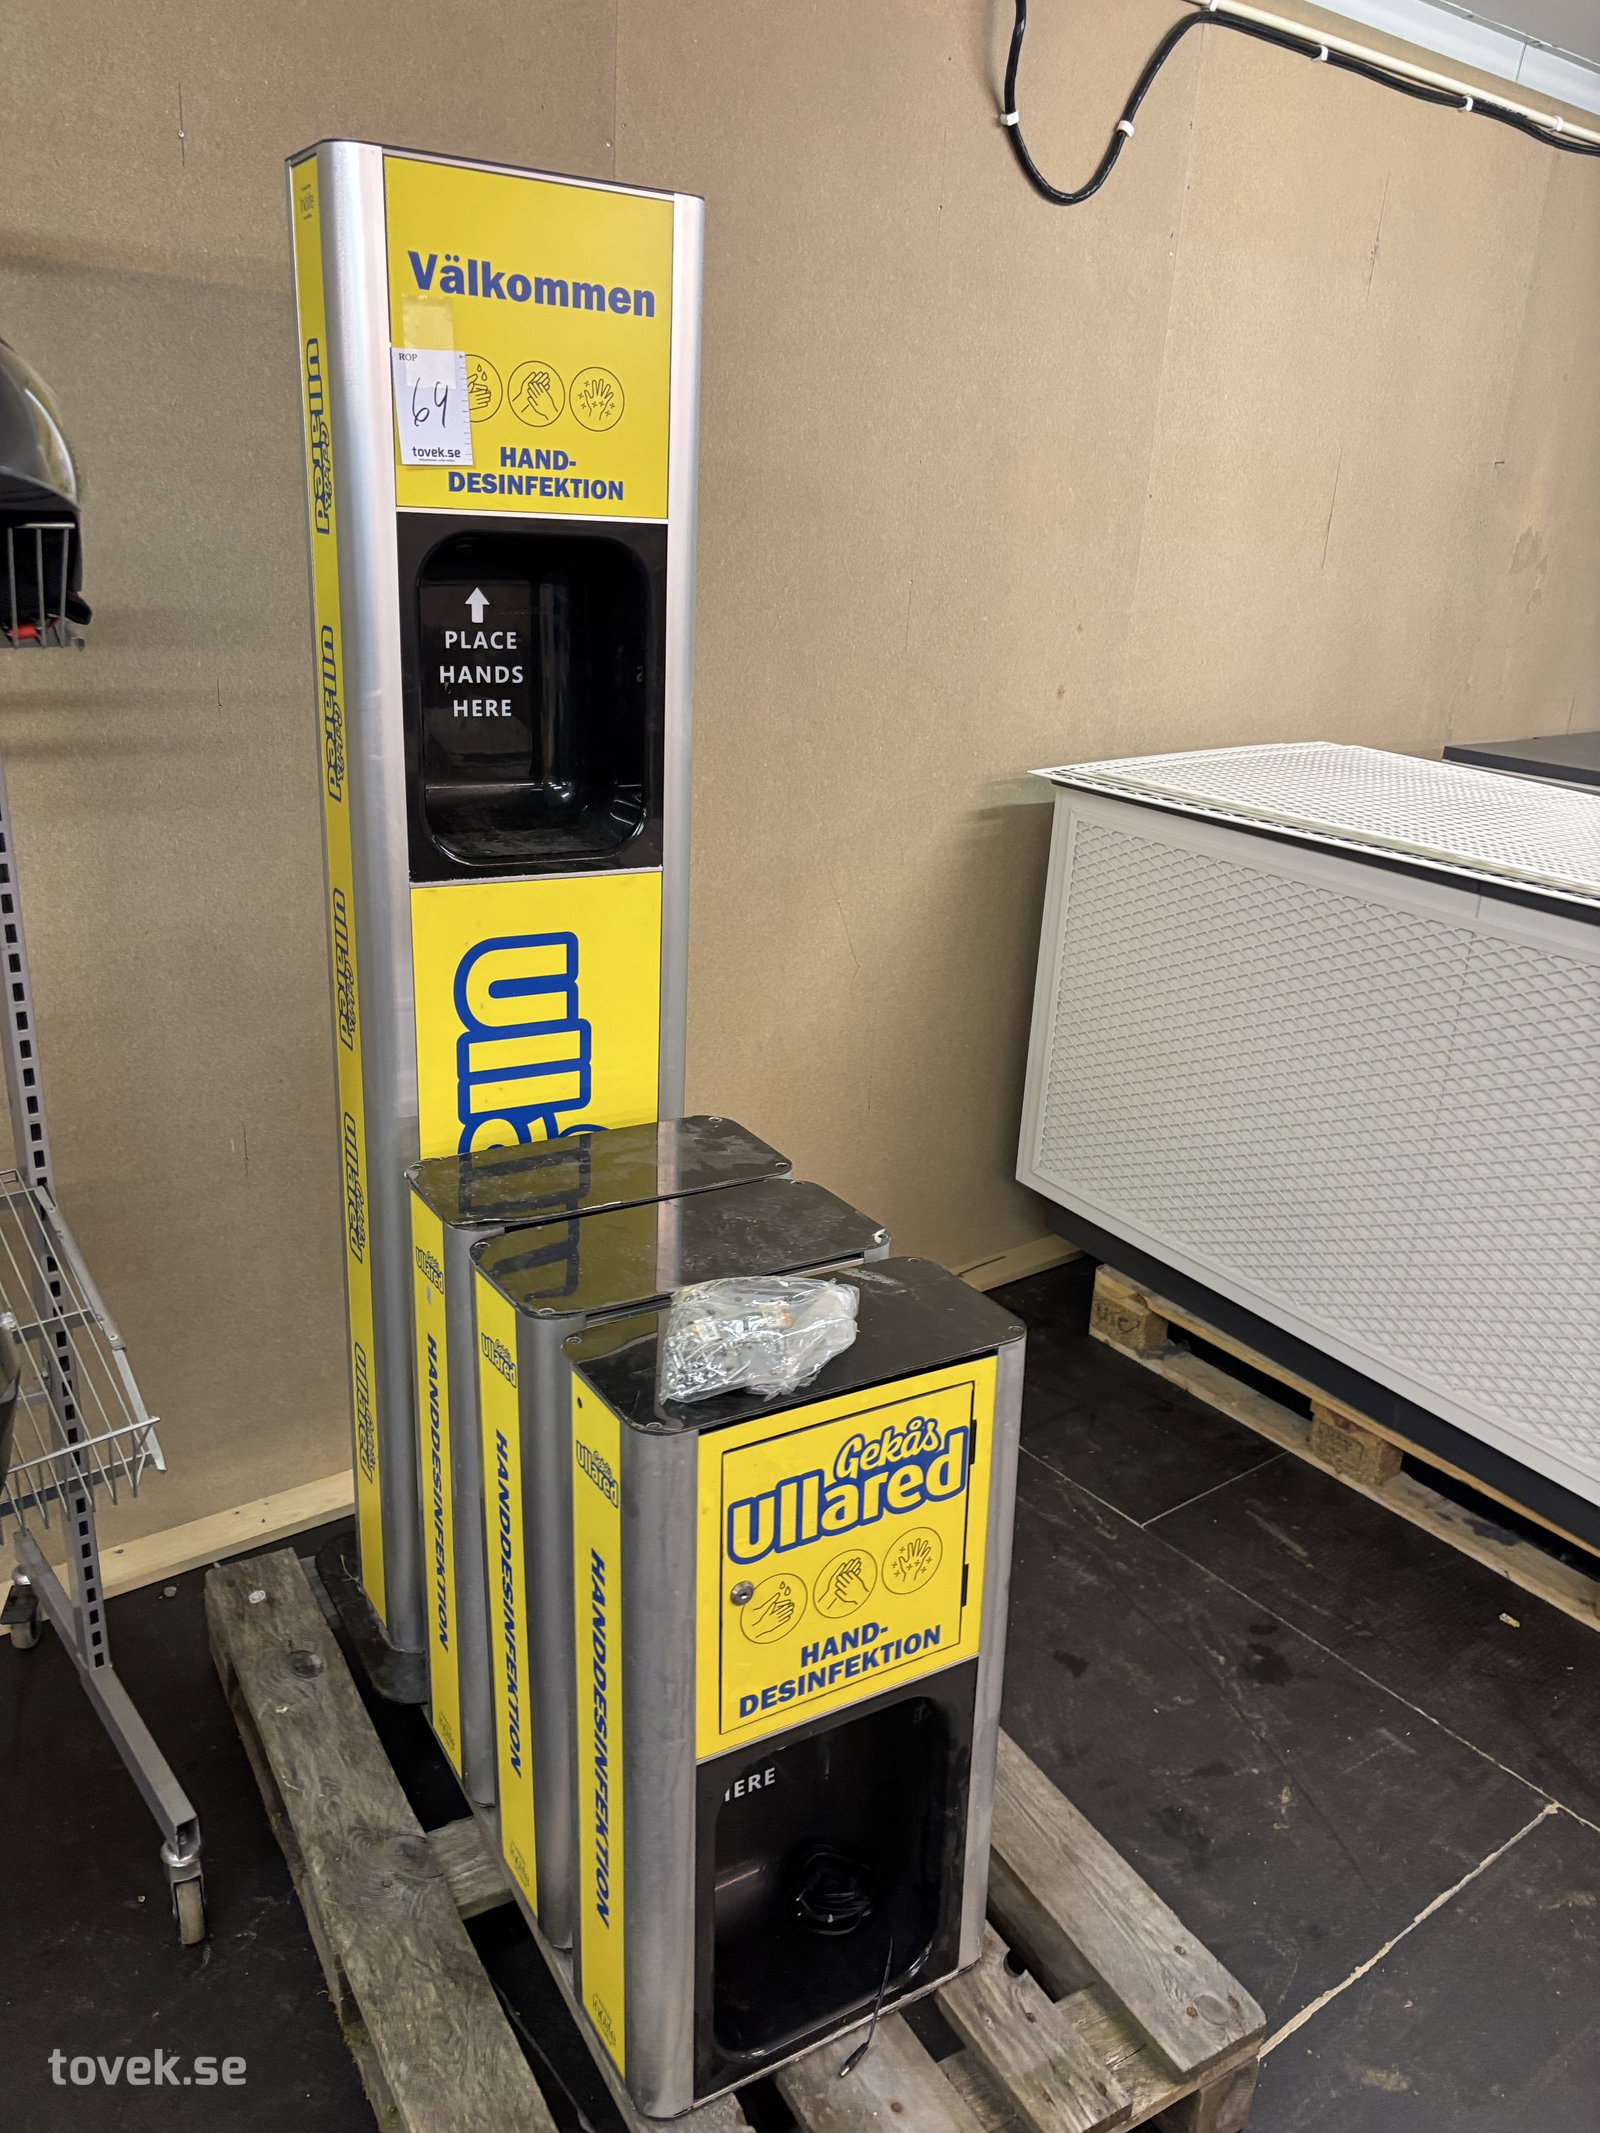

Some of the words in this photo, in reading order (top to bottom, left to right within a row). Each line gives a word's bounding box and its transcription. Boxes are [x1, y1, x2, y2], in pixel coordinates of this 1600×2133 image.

[408, 250, 655, 317] Välkommen
[398, 353, 418, 361] ROP
[306, 338, 330, 535] Ullared
[412, 446, 461, 458] tovek.se
[500, 447, 577, 470] HAND-
[448, 472, 624, 501] DESINFEKTION
[445, 631, 518, 650] PLACE
[439, 666, 524, 684] HANDS
[453, 700, 512, 717] HERE
[833, 1415, 942, 1483] Gekås
[427, 1332, 449, 1653] HANDDESINFEKTION
[727, 1426, 970, 1565] Ullared
[495, 1428, 522, 1778] HANDDESINFEKTION
[739, 1624, 942, 1718] DESINFEKTION
[800, 1621, 889, 1667] HAND-
[591, 1548, 611, 1929] HANDDESINFEKTION
